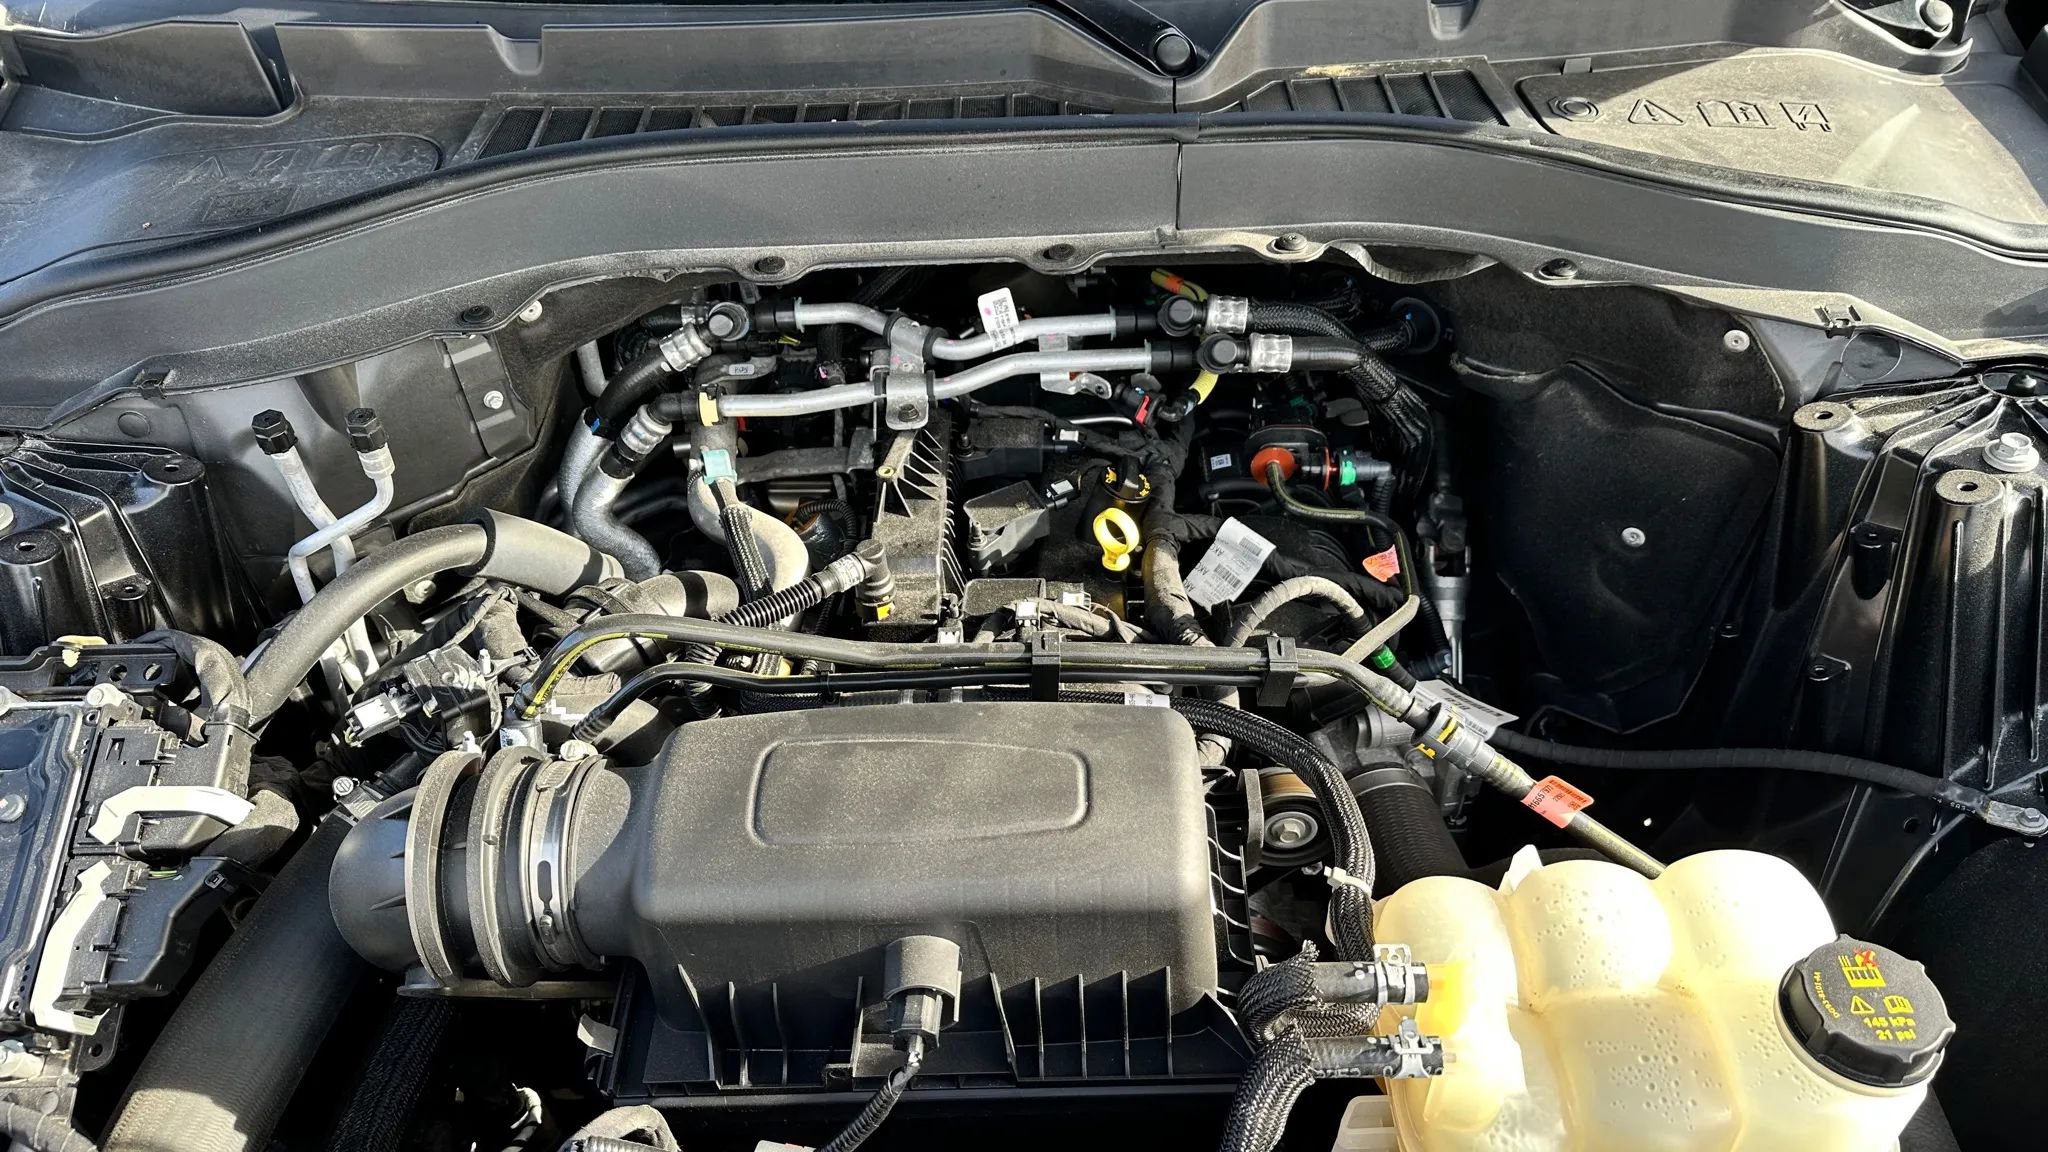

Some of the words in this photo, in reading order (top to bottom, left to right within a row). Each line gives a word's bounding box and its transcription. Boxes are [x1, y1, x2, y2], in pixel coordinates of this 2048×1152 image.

[1863, 1017, 1888, 1028] 145
[1888, 1016, 1916, 1027] kPa
[1876, 1030, 1893, 1040] 21
[1896, 1029, 1916, 1041] psi
